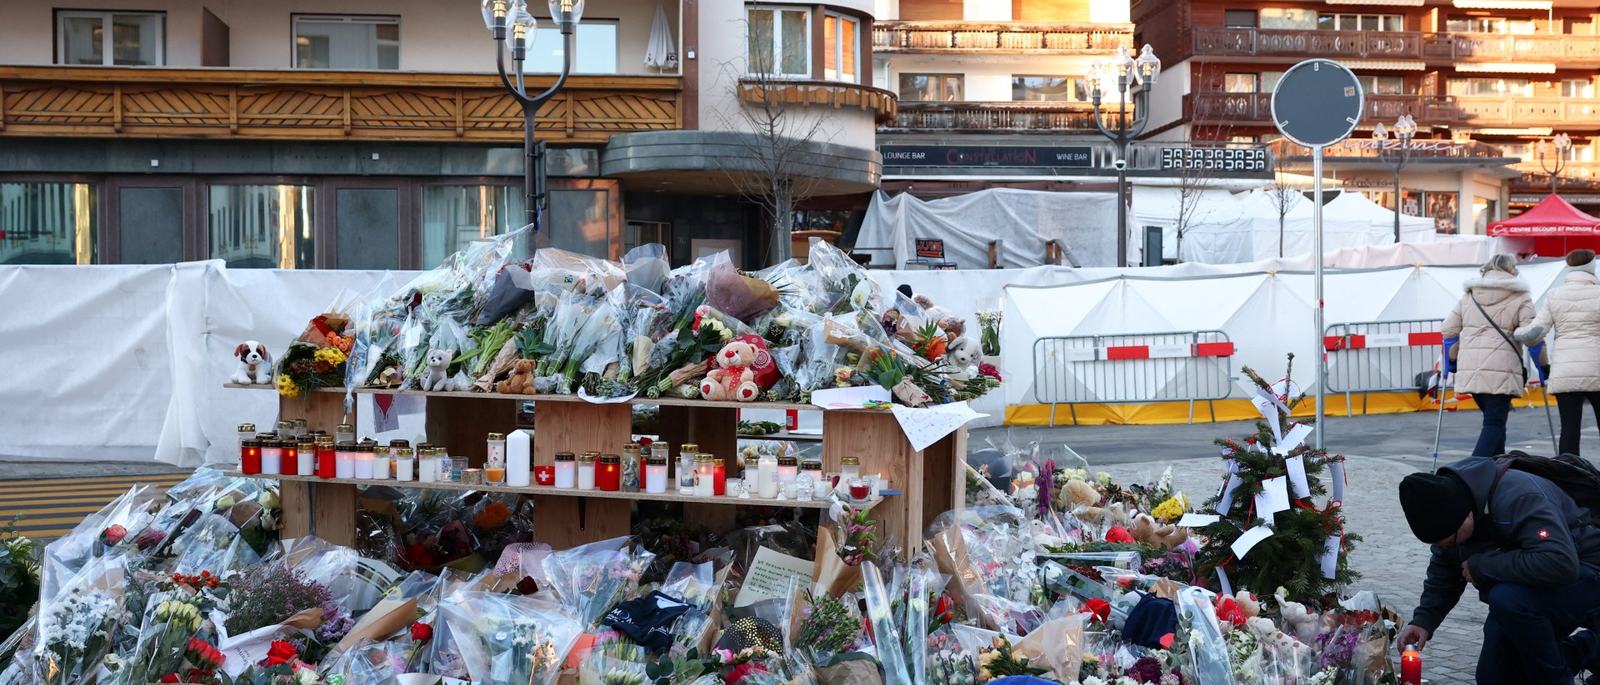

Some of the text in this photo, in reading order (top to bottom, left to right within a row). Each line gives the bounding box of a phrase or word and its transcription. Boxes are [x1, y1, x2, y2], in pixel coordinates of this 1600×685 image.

[883, 152, 926, 160] LOUNGE BAR
[1056, 153, 1088, 161] WINE BAR
